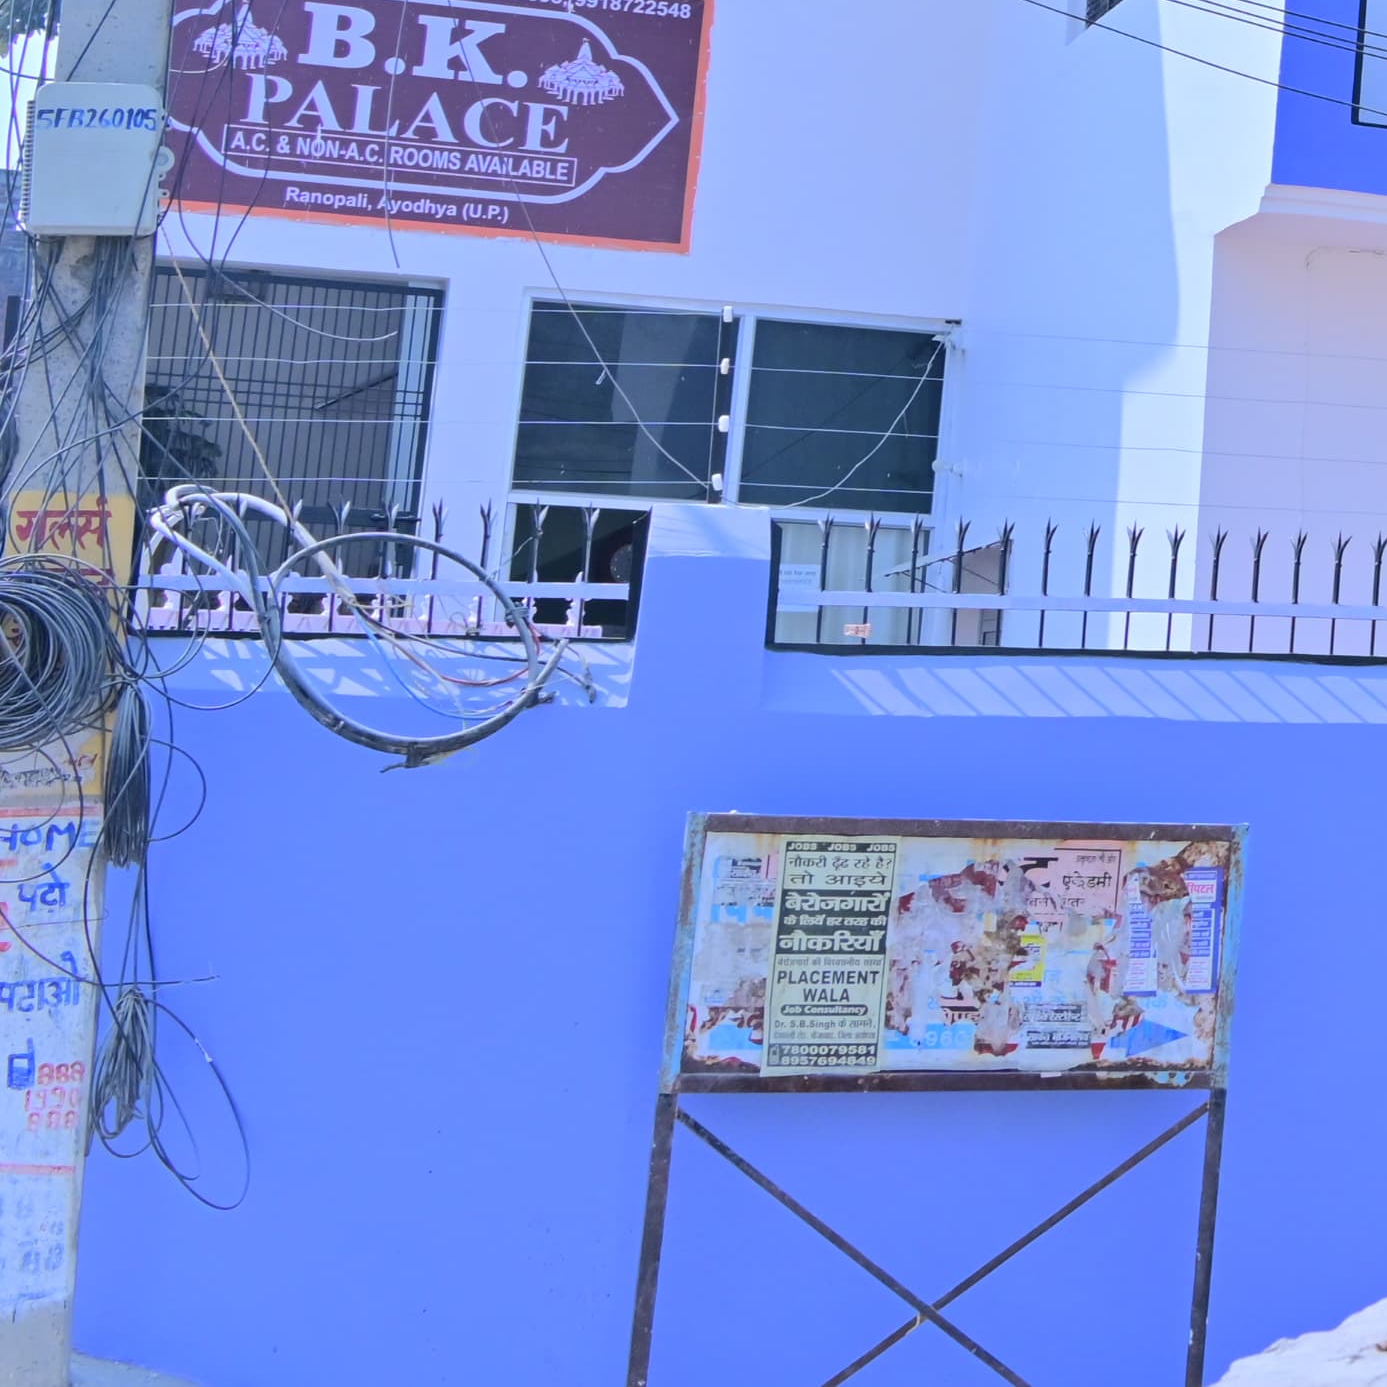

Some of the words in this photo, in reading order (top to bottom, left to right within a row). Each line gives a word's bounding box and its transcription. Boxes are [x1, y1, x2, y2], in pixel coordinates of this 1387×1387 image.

[297, 1, 528, 89] B.K.
[239, 73, 570, 153] PALACE
[231, 131, 270, 152] A.C.
[276, 135, 290, 154] &
[296, 137, 384, 163] NON-A.C.
[389, 145, 461, 171] ROOMS
[465, 154, 569, 181] AVAILABLE
[286, 186, 373, 211] Ranopali,
[377, 195, 457, 218] Ayodhya
[463, 203, 509, 224] (U.P.)
[788, 842, 818, 852] JOBS
[827, 842, 858, 852] JOBS
[866, 843, 897, 853] JOBS
[788, 870, 815, 885] तो
[777, 970, 880, 985] PLACEMENT
[803, 988, 850, 1003] WALA
[783, 1004, 802, 1014] Job
[804, 1005, 867, 1016] Consultancy
[774, 1020, 786, 1029] Dr.
[782, 1045, 877, 1055] 7800079581
[781, 1055, 877, 1066] 8957694849
